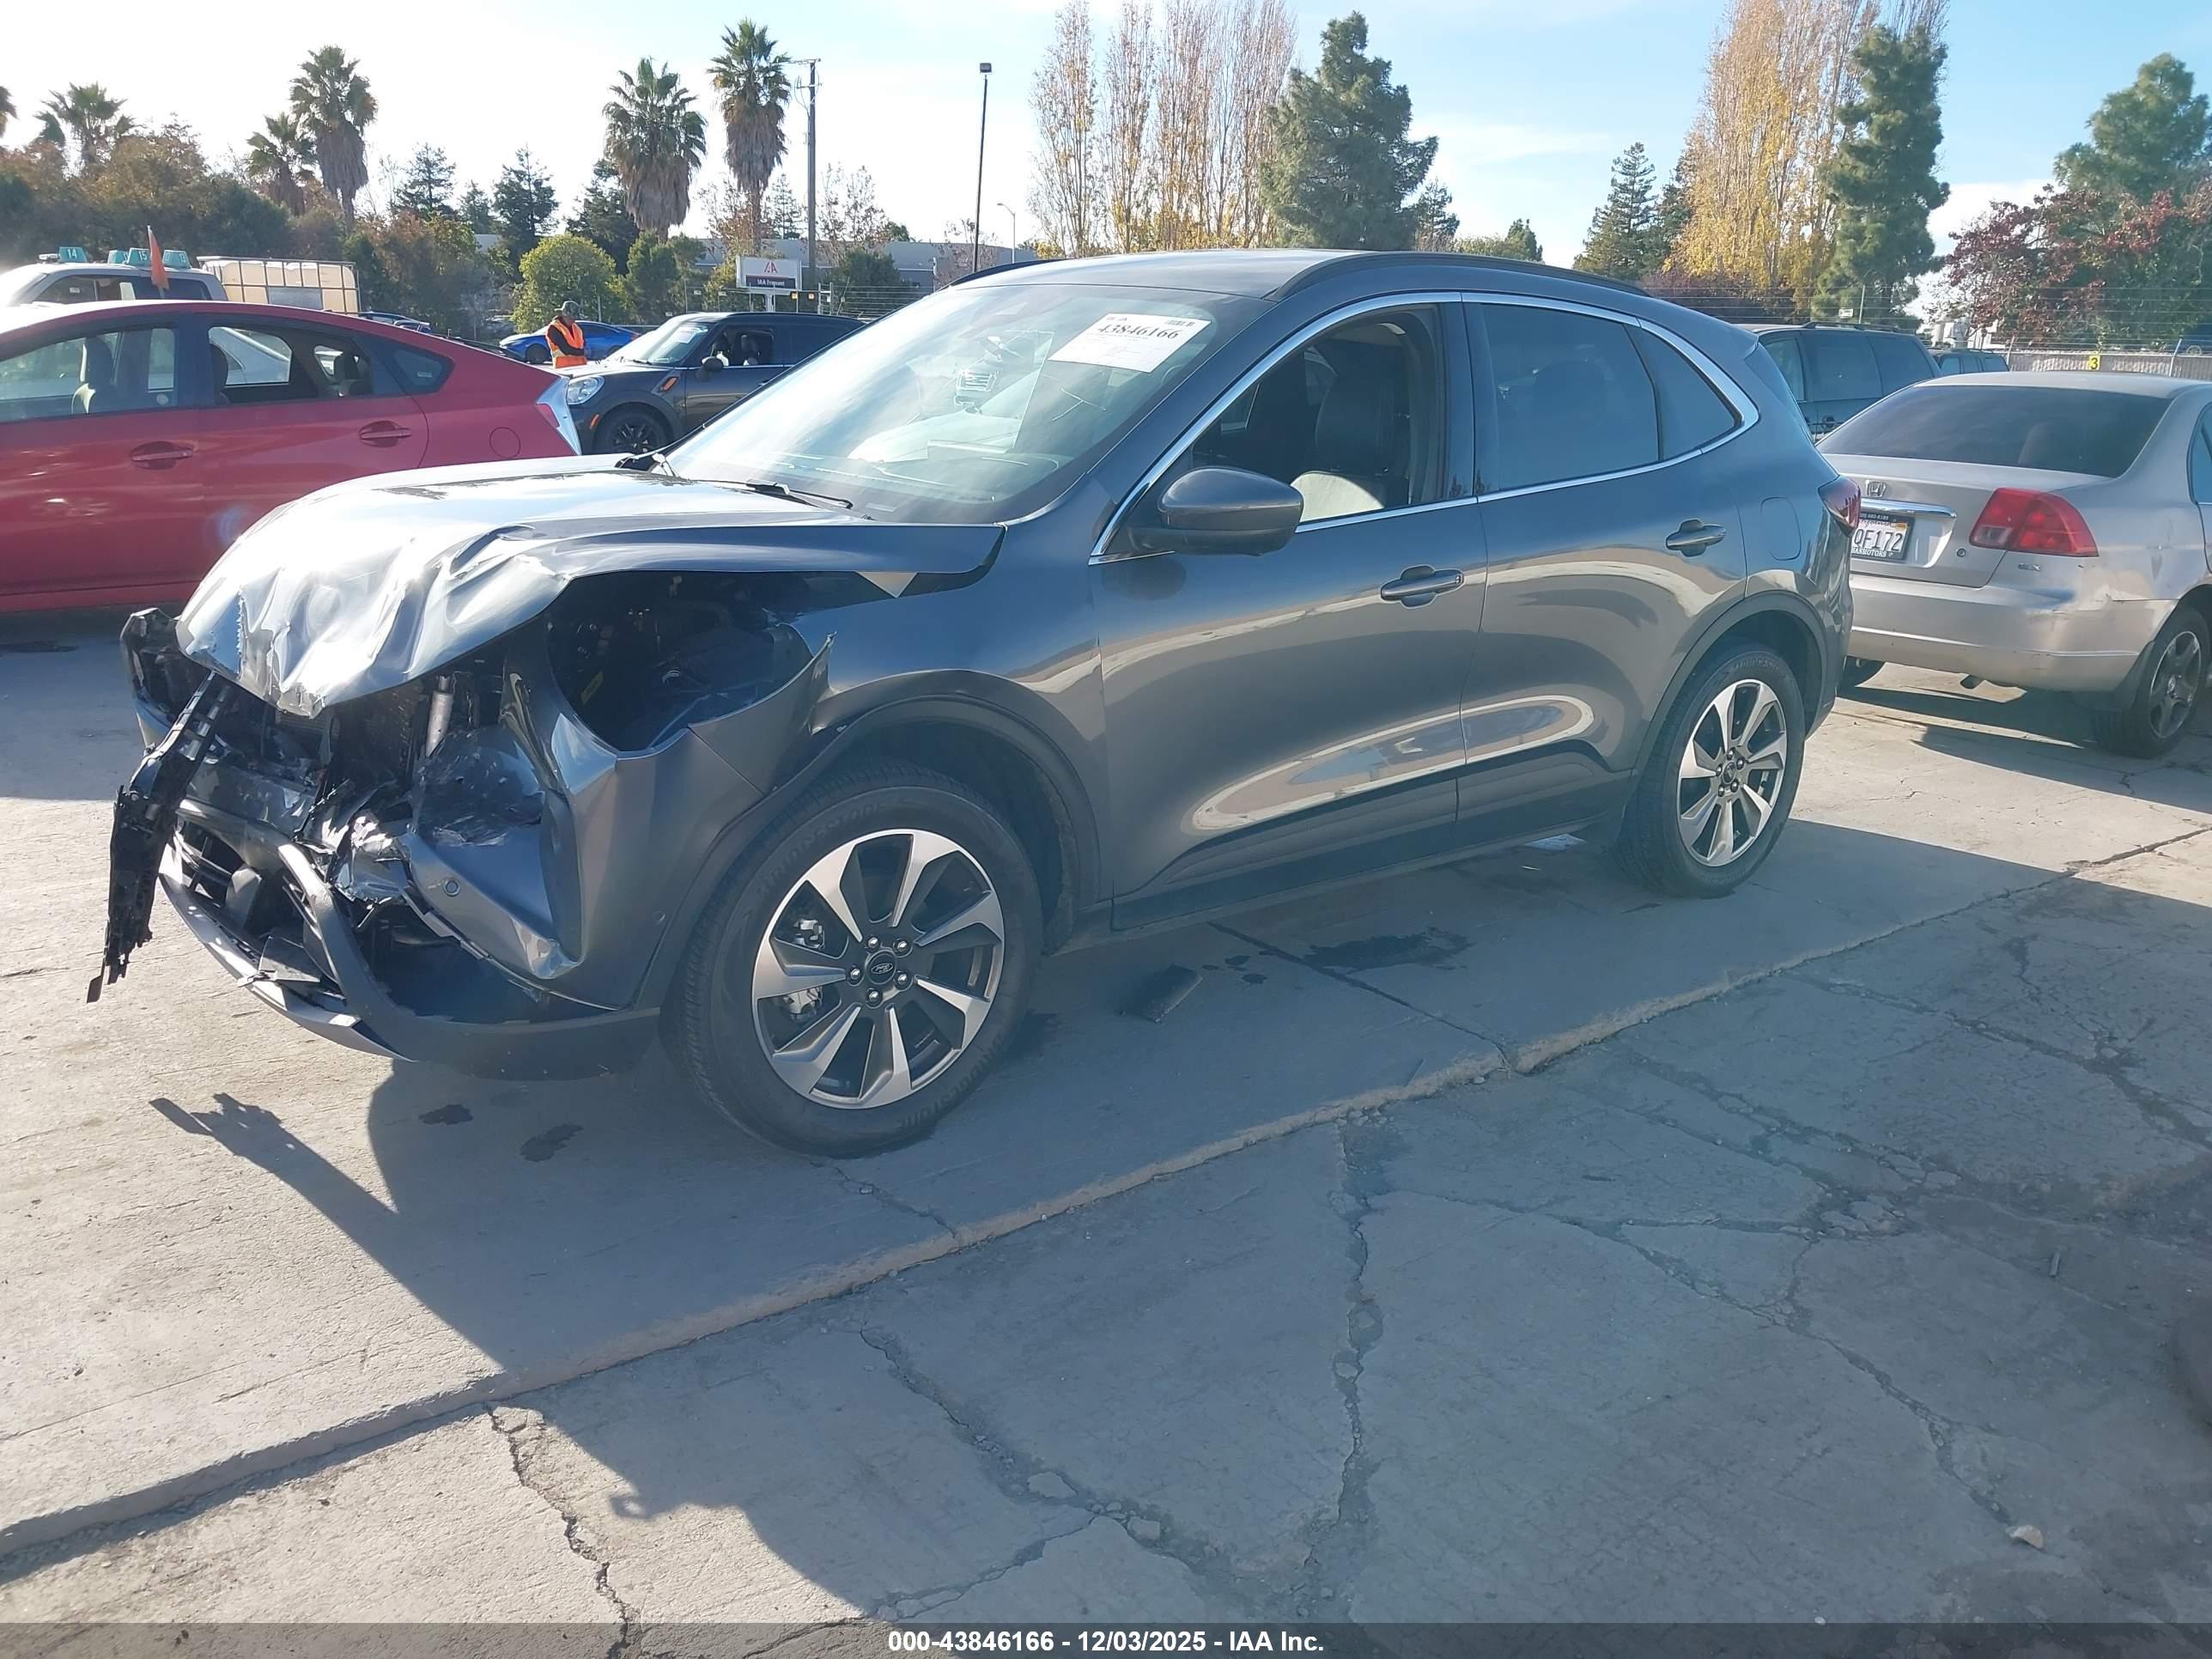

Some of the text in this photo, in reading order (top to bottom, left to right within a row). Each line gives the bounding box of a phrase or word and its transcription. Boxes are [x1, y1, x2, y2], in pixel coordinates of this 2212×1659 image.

[67, 248, 77, 259] 14
[138, 250, 148, 261] 15
[1097, 323, 1182, 340] 43846166
[2090, 356, 2099, 370] 3
[1854, 528, 1903, 551] QF172
